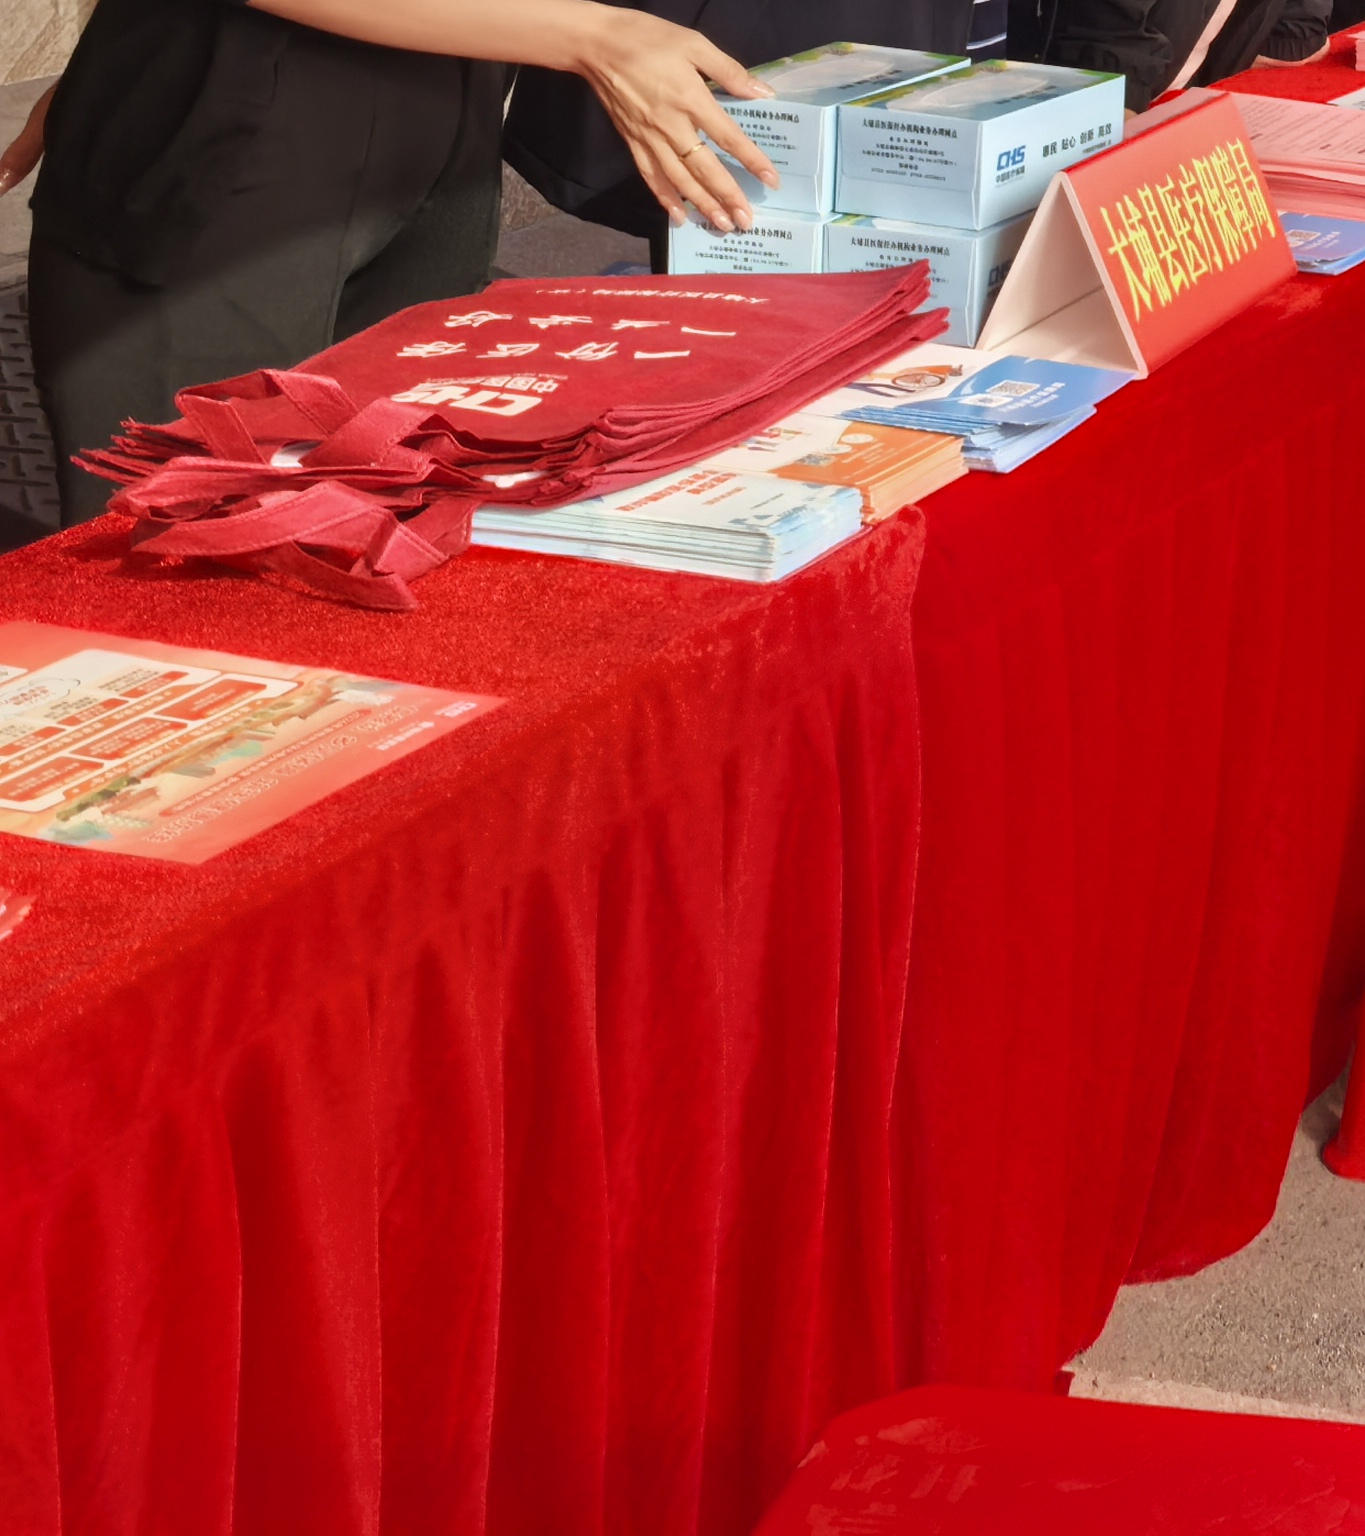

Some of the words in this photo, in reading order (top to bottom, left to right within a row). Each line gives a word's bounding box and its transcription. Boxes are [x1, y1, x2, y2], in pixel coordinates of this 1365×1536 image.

[996, 144, 1026, 172] CHS
[1100, 137, 1276, 324] 大埔县医疗保障局
